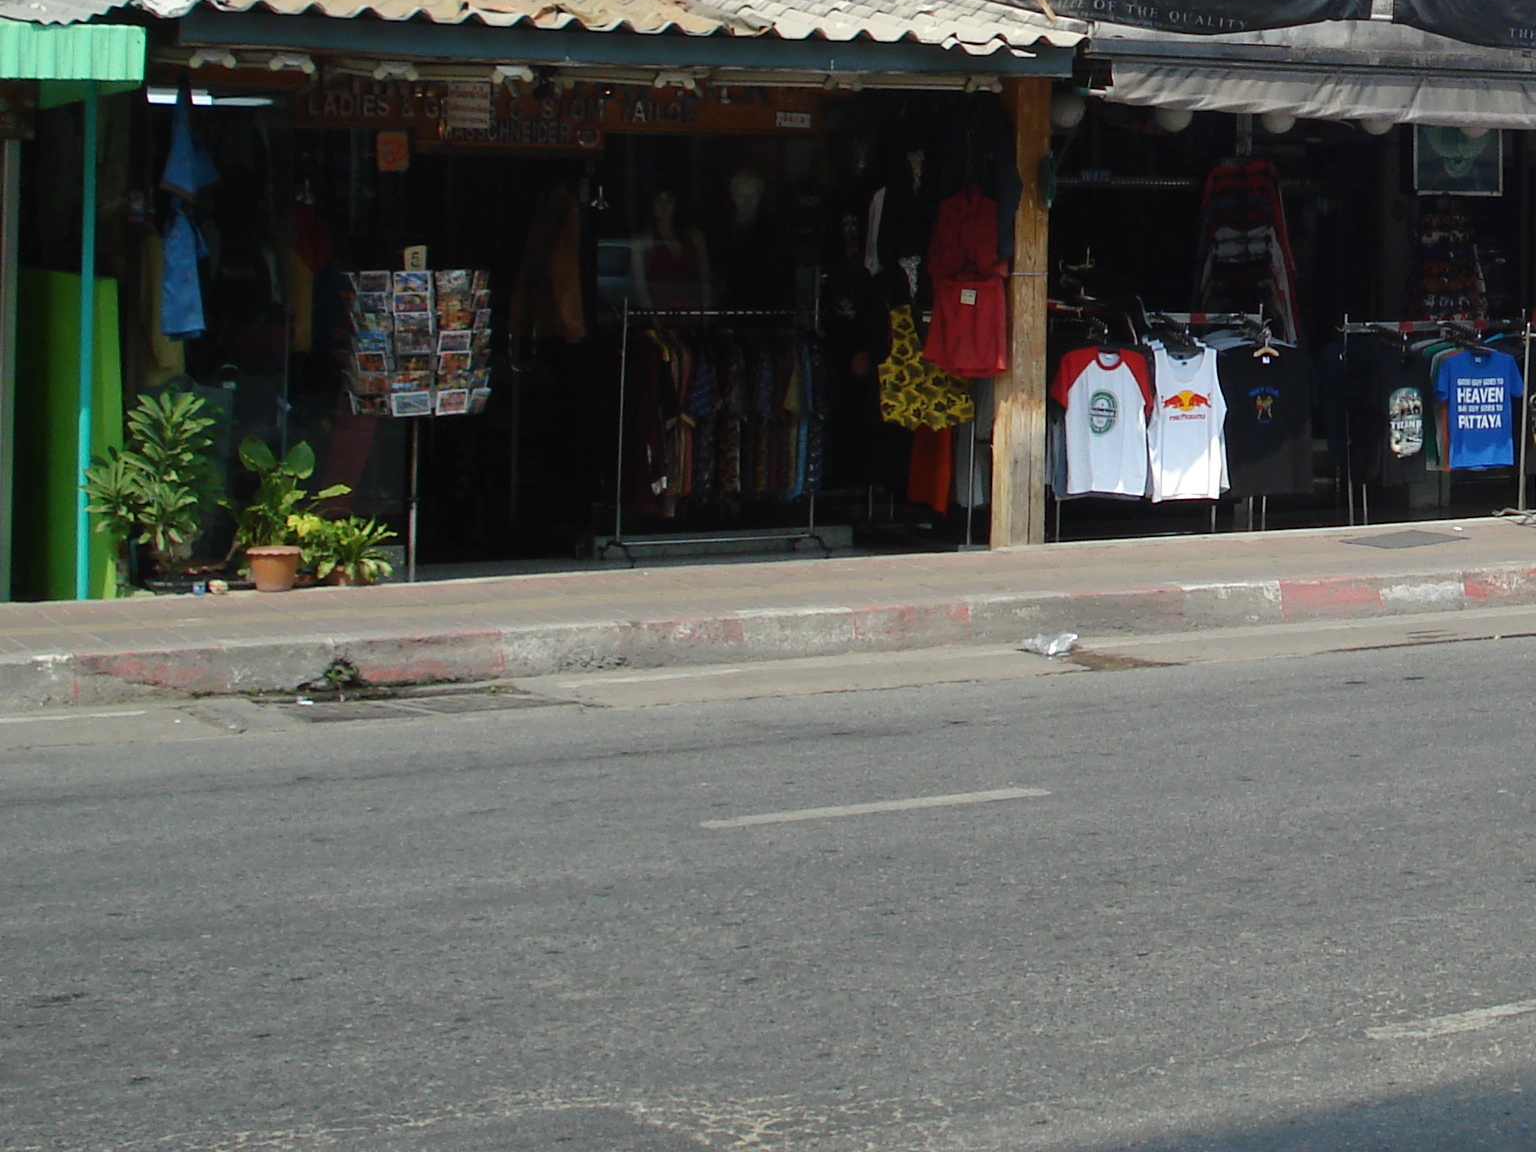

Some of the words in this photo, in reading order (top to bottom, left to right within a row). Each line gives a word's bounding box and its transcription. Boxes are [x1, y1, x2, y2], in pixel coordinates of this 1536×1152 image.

[1092, 0, 1116, 12] OF
[1126, 3, 1159, 18] THE
[1168, 10, 1248, 30] QUALITY
[1508, 27, 1536, 40] THE
[308, 95, 391, 117] LADIES
[1457, 387, 1504, 404] HEAVEN
[1458, 414, 1502, 429] PATTAYA
